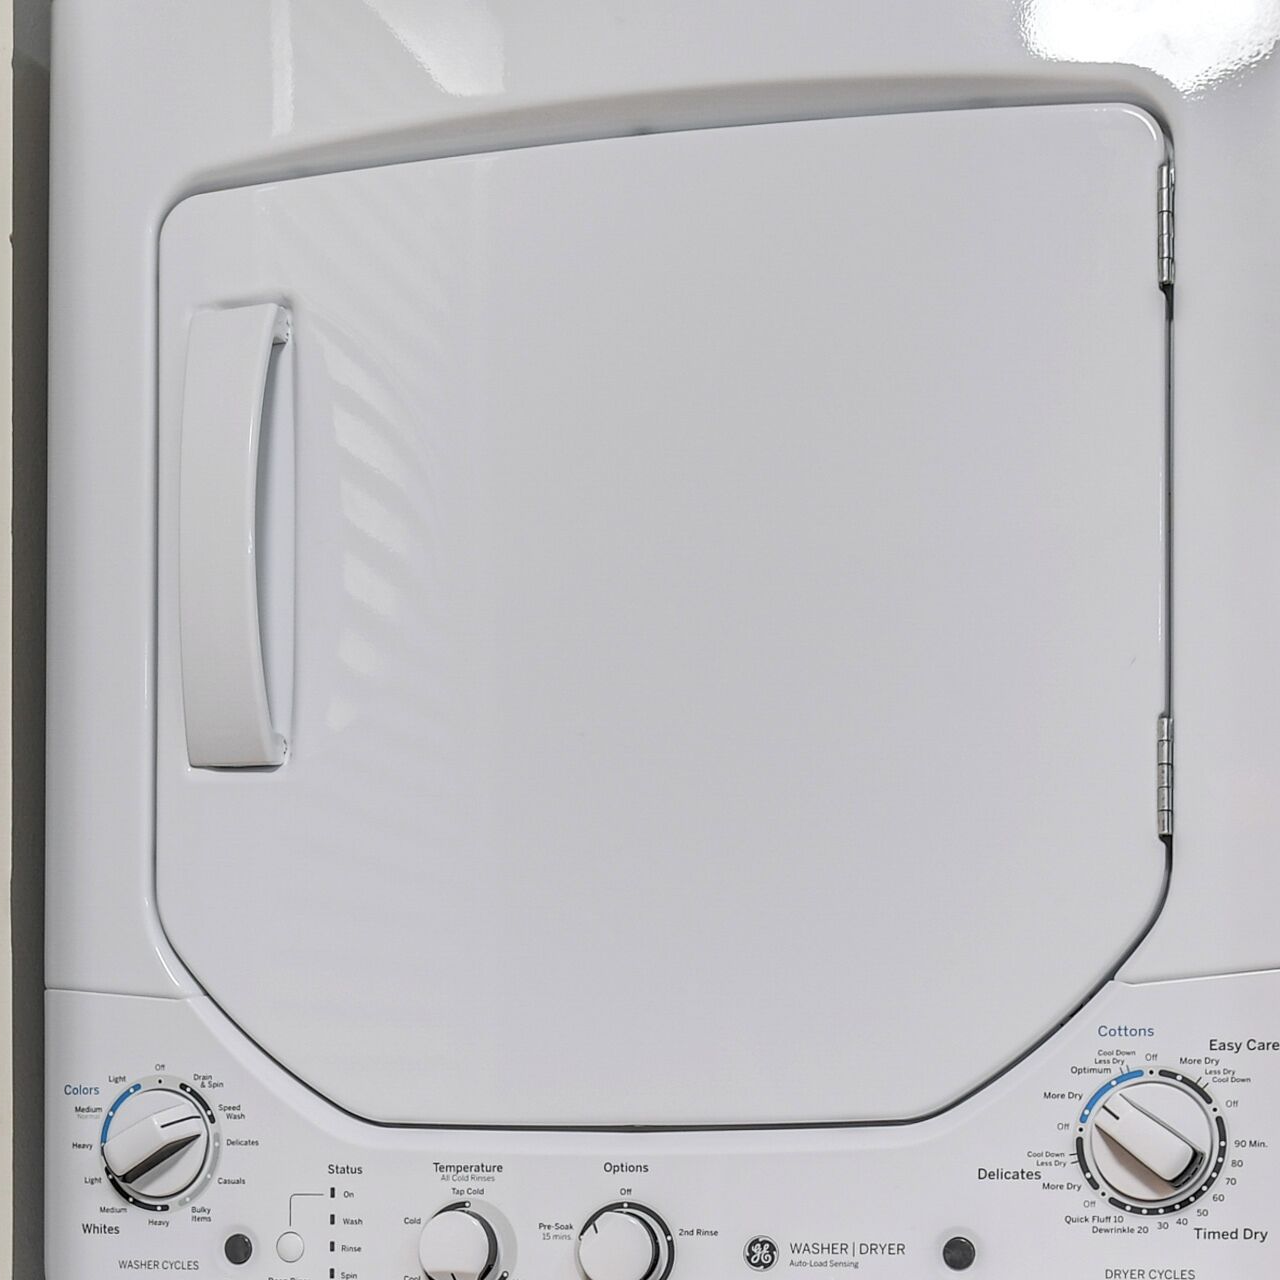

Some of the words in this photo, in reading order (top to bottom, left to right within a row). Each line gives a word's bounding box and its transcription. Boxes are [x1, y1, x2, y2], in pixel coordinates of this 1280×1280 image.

[1097, 1025, 1154, 1038] Cottons
[1209, 1039, 1242, 1053] Easy
[1246, 1039, 1280, 1051] Care
[1145, 1053, 1158, 1061] Off
[1112, 1058, 1124, 1066] Dry
[1180, 1057, 1200, 1065] More
[1201, 1057, 1219, 1066] Dry
[1070, 1066, 1111, 1075] Optimum
[1222, 1068, 1236, 1077] Dry
[109, 1075, 126, 1083] Light
[194, 1073, 213, 1081] Drain
[208, 1080, 224, 1090] Spin
[64, 1085, 100, 1096] Colors
[1043, 1092, 1064, 1100] More
[1065, 1092, 1083, 1101] Dry
[1226, 1100, 1238, 1108] Off
[218, 1104, 241, 1113] Speed
[226, 1112, 246, 1120] Wash
[1057, 1123, 1069, 1131] Off
[72, 1142, 93, 1150] Heavy
[1234, 1140, 1247, 1148] 90
[1249, 1140, 1268, 1148] Min.
[433, 1162, 503, 1174] Temperature
[603, 1162, 649, 1174] Options
[1053, 1160, 1067, 1168] Dry
[1231, 1160, 1243, 1168] 80
[328, 1164, 363, 1175] Status
[452, 1174, 468, 1182] Cold
[977, 1168, 1042, 1180] Delicates
[84, 1177, 102, 1185] Light
[1226, 1178, 1237, 1186] 70
[1042, 1182, 1063, 1190] More
[1063, 1182, 1081, 1192] Dry
[343, 1191, 354, 1199] On
[452, 1188, 466, 1196] Tap
[620, 1188, 632, 1196] Off
[1213, 1194, 1225, 1202] 60
[1083, 1200, 1096, 1208] Off
[99, 1206, 127, 1214] Medium
[191, 1207, 211, 1216] Bulky
[1197, 1209, 1208, 1217] 50
[148, 1219, 170, 1228] Heavy
[404, 1217, 421, 1225] Cold
[1064, 1215, 1089, 1224] Quick
[1092, 1215, 1111, 1224] Fluff
[1113, 1215, 1124, 1223] 10
[1176, 1218, 1188, 1226] 40
[82, 1223, 120, 1235] Whites
[539, 1223, 574, 1231] Pre-Soak
[1092, 1226, 1134, 1234] Dewrinkle
[1137, 1226, 1149, 1234] 20
[1157, 1222, 1169, 1230] 30
[1194, 1228, 1238, 1240] Timed
[1243, 1228, 1268, 1243] Dry
[790, 1243, 848, 1255] WASHER
[859, 1243, 906, 1255] DRYER
[118, 1260, 159, 1270] WASHER
[161, 1260, 199, 1270] CYCLES
[830, 1260, 859, 1269] Sensing
[341, 1272, 357, 1280] Spin
[1105, 1269, 1145, 1280] DRYER
[1149, 1270, 1195, 1280] CYCLES
